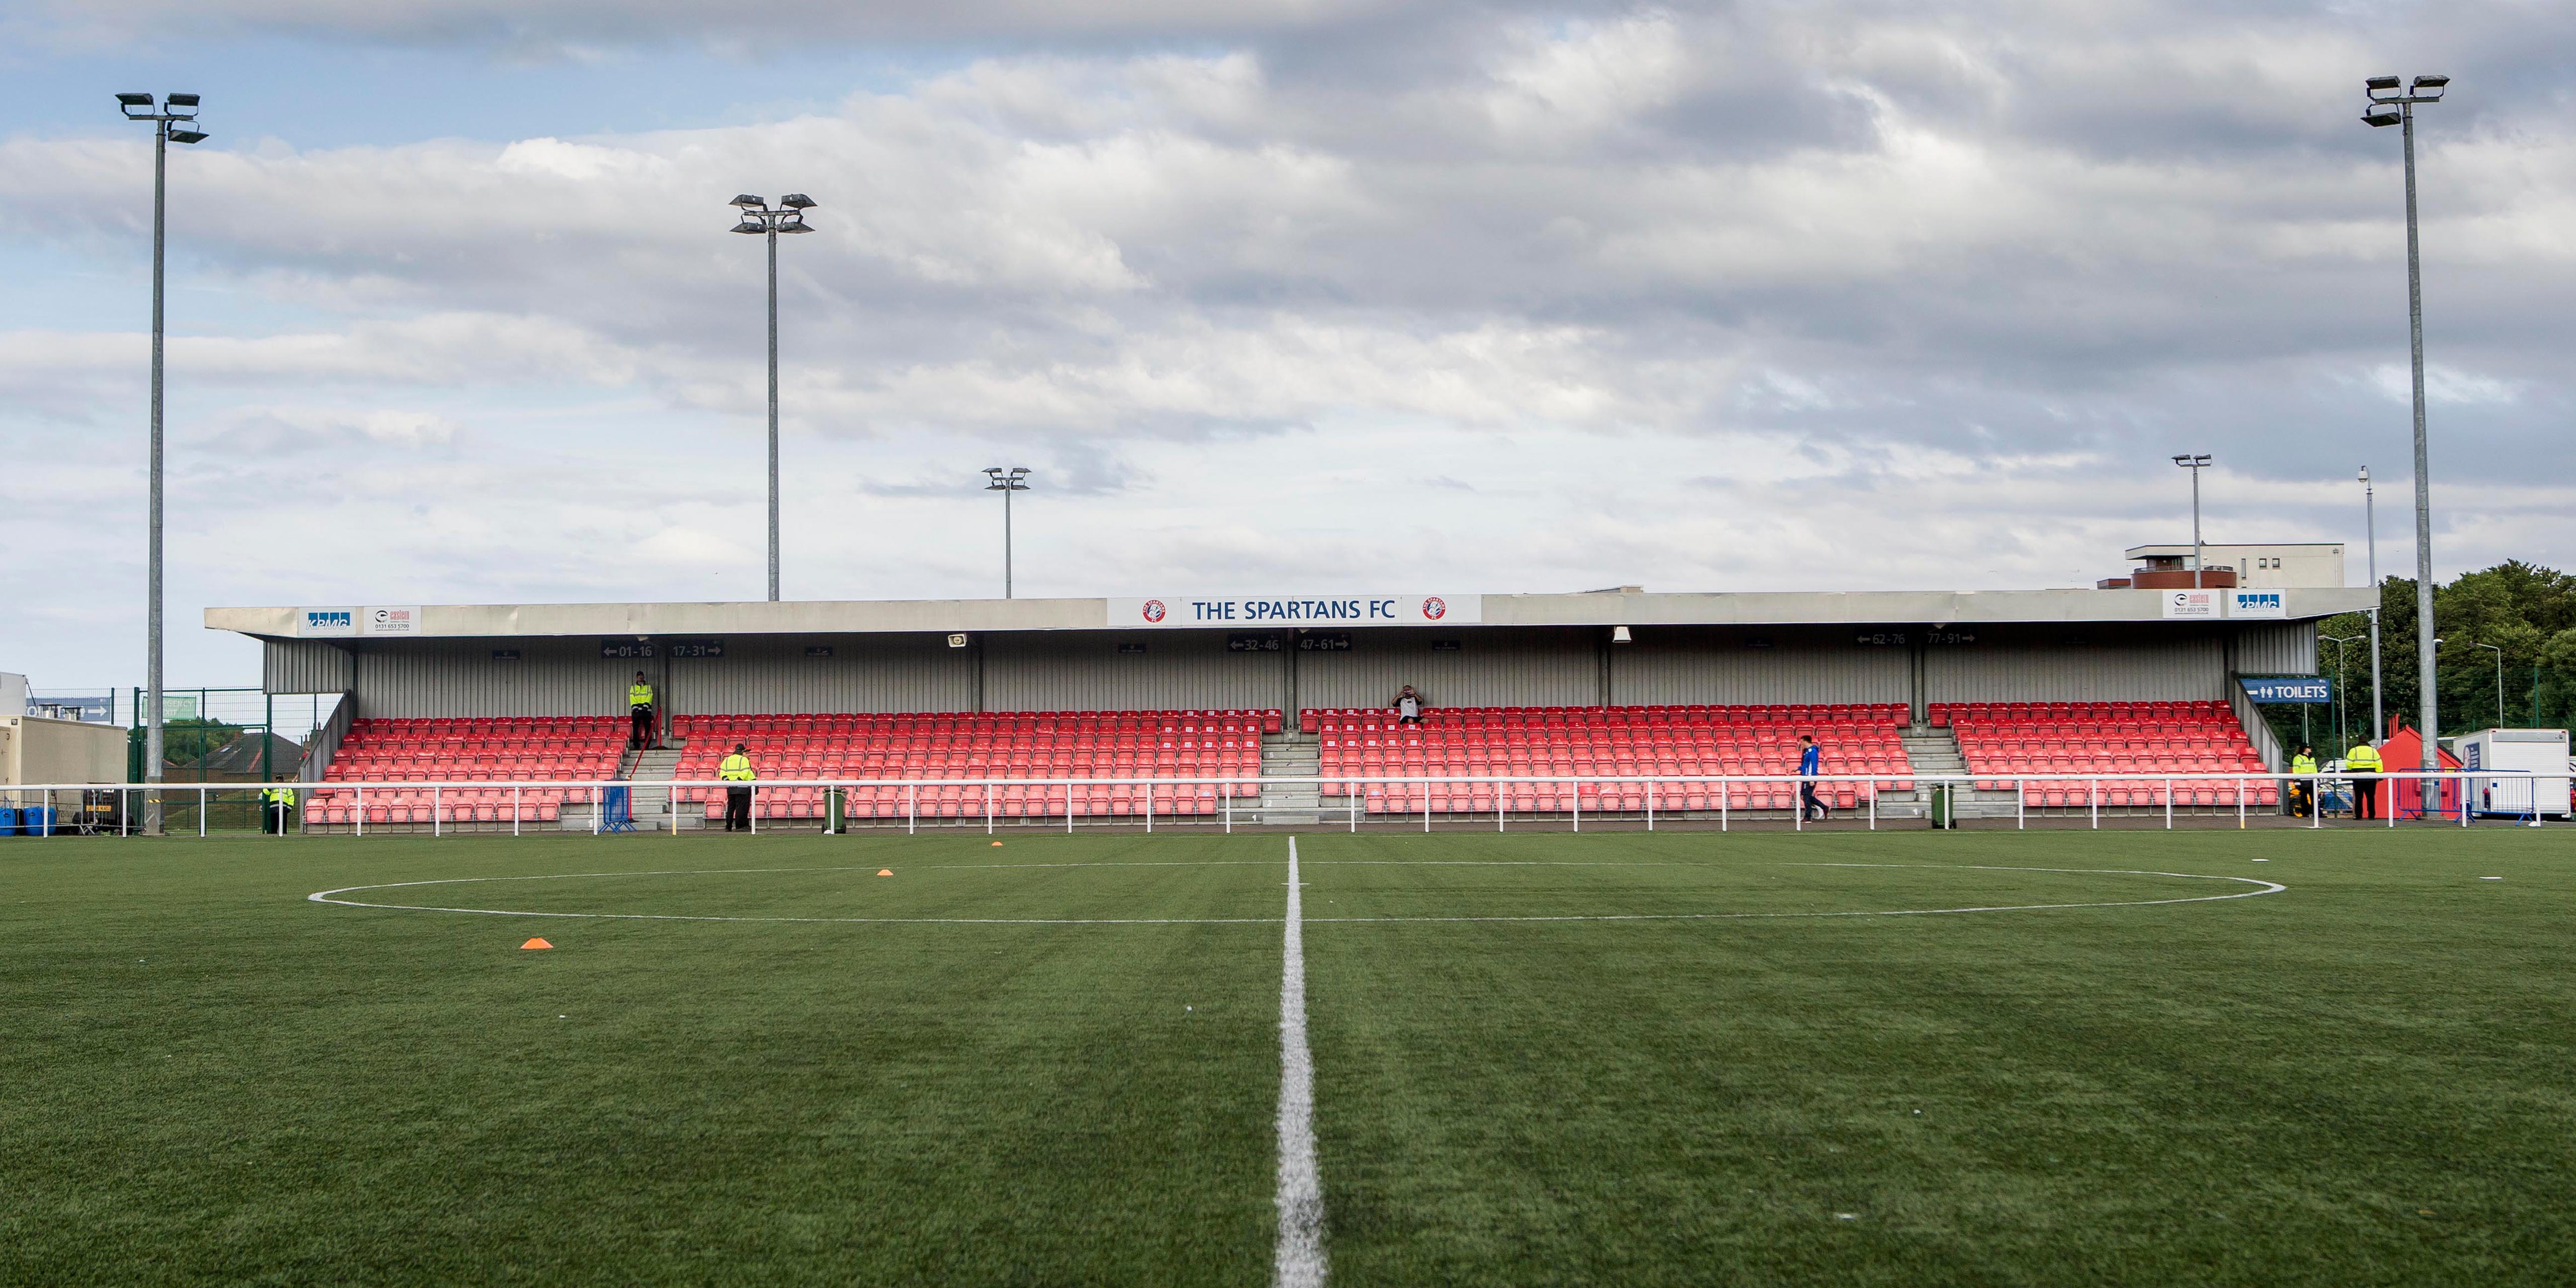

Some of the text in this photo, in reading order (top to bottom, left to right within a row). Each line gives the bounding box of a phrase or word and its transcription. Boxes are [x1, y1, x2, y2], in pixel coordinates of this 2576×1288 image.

[1192, 600, 1395, 619] THE SPARTANS FC
[2236, 601, 2277, 612] KPMG
[390, 610, 410, 620] eastern
[306, 619, 348, 630] KPMG
[2275, 686, 2327, 698] TOILETS
